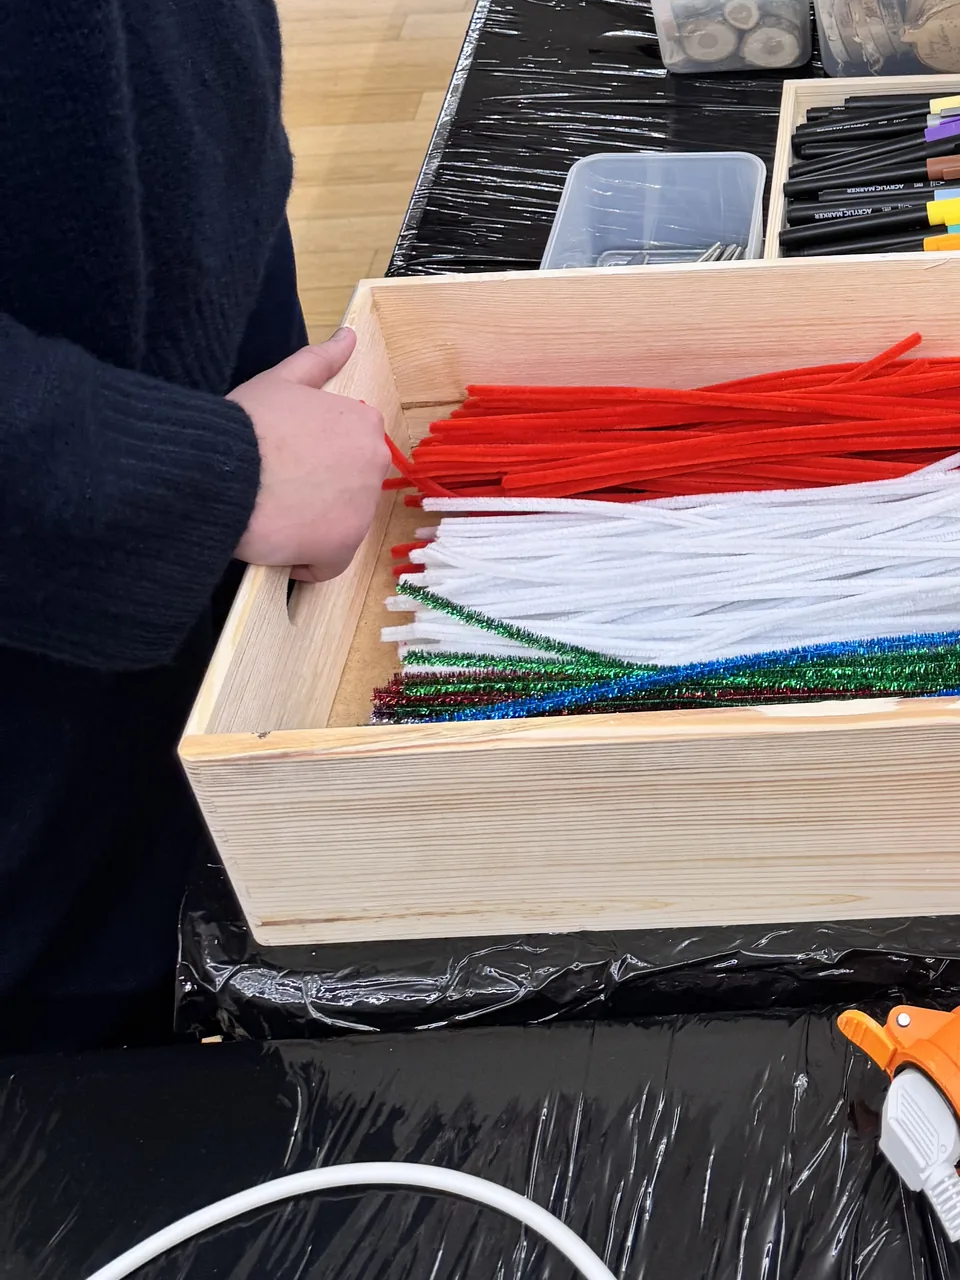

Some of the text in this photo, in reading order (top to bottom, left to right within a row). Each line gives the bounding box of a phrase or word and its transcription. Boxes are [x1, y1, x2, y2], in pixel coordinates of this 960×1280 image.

[846, 185, 875, 194] MARKER
[875, 183, 904, 191] ACRYLIC
[814, 211, 843, 220] MARKER
[843, 208, 872, 217] ACRYLIC
